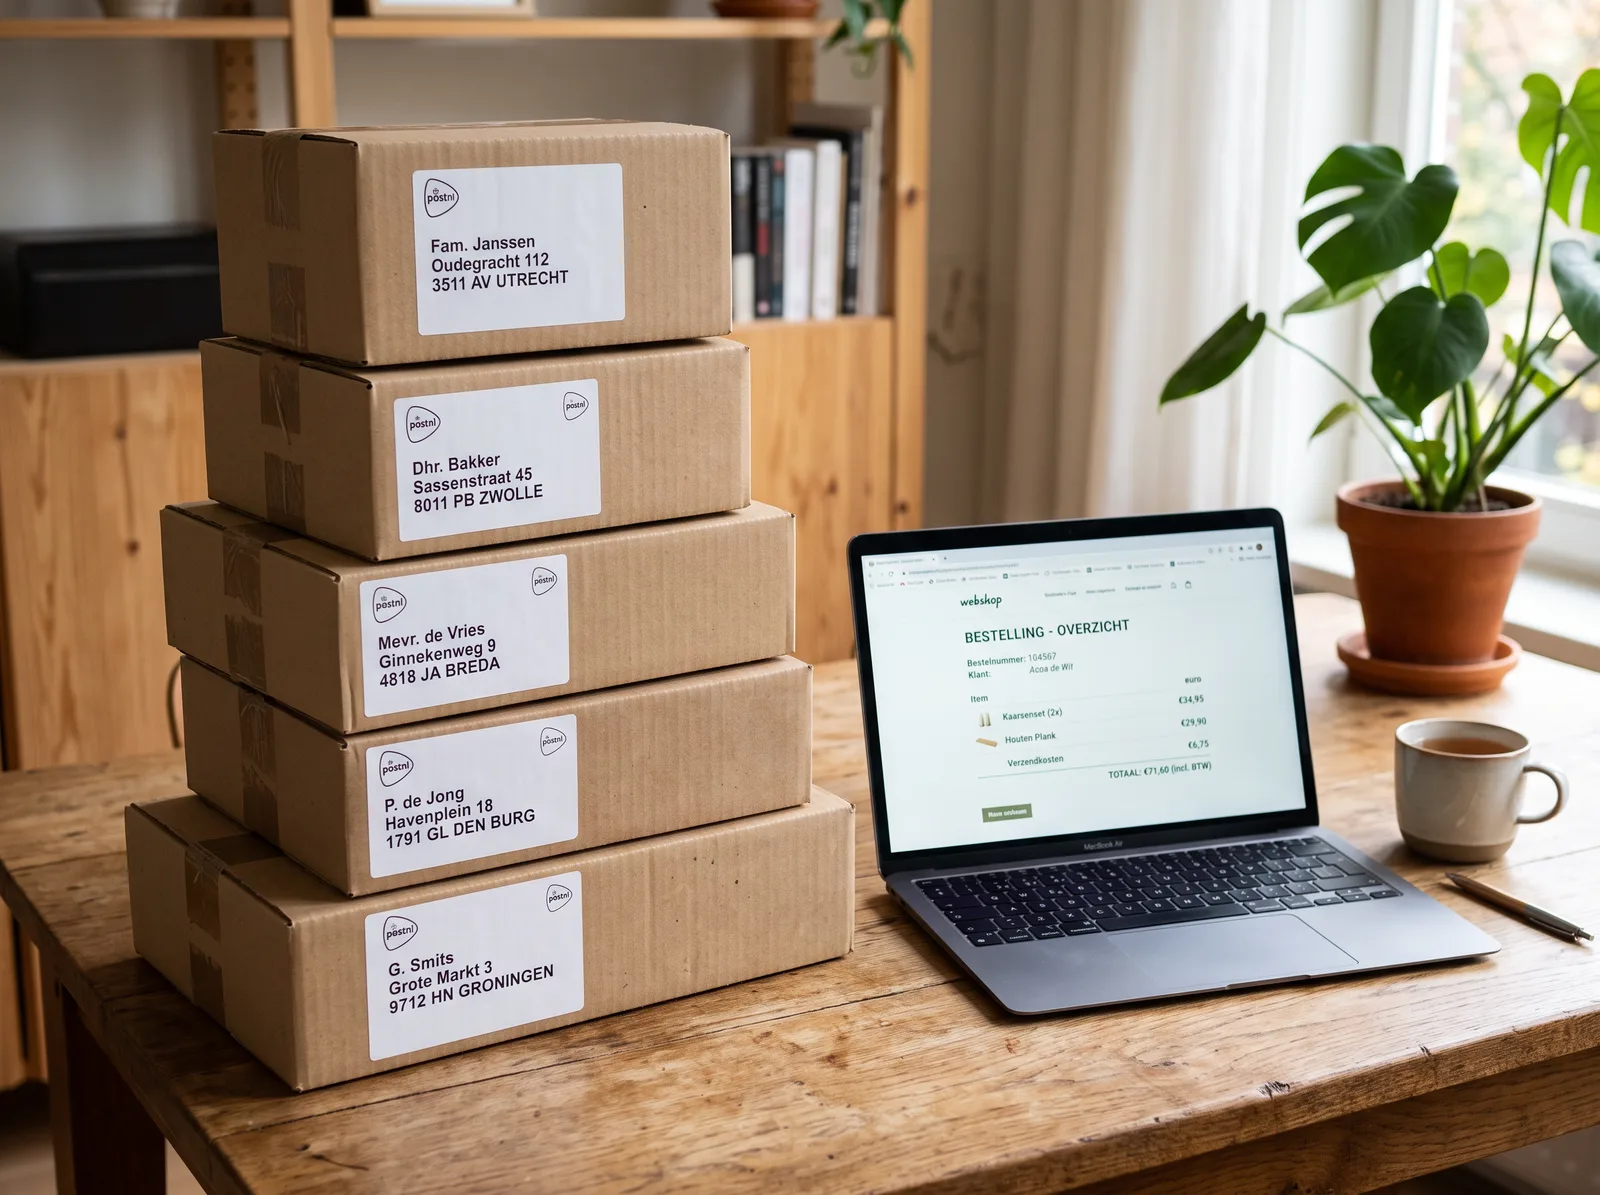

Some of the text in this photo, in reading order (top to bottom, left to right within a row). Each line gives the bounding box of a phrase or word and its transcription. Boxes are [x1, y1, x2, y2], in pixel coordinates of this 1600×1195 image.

[427, 193, 454, 204] postnl
[431, 237, 535, 253] Fam. Janssen
[431, 252, 549, 273] Oudegracht 112
[432, 270, 569, 292] 3511 AV UTRECHT
[566, 401, 586, 411] postnl
[410, 418, 436, 431] postnl
[413, 455, 500, 476] Dhr. Bakker
[413, 467, 532, 495] Sassenstraat 45
[414, 484, 543, 513] 8011 PB ZWOLLE
[534, 576, 555, 586] postnl
[376, 598, 403, 612] postnl
[378, 624, 485, 650] Mevr. de Vries
[965, 626, 1045, 644] BESTELLING
[1057, 619, 1130, 636] OVERZICHT
[379, 638, 496, 669] Ginnekenweg 9
[967, 652, 1057, 667] Bestelnummer: 104567
[379, 656, 500, 687] 4818 JA BREDA
[968, 670, 991, 679] Klant:
[1050, 663, 1059, 672] de
[1184, 676, 1202, 684] euro
[970, 695, 989, 703] Item
[1002, 694, 1204, 721] Kaarsenset (2x) €34,95
[1005, 717, 1207, 744] Houten Plank €29,90
[542, 736, 563, 747] postnl
[1007, 739, 1209, 767] Verzendkosten €6,75
[382, 761, 409, 775] postnl
[1108, 761, 1212, 779] TOTAAL: €71,60 (incl. BTW)
[385, 788, 464, 813] P. de Jong
[386, 799, 493, 831] Havenplein 18
[386, 808, 535, 849] 1791 GL DEN BURG
[548, 891, 570, 903] postnl
[386, 925, 414, 940] postnl
[389, 952, 454, 977] G. Smits
[389, 960, 493, 995] Grote Markt 3
[389, 964, 554, 1014] 9712 HN GRONINGEN
